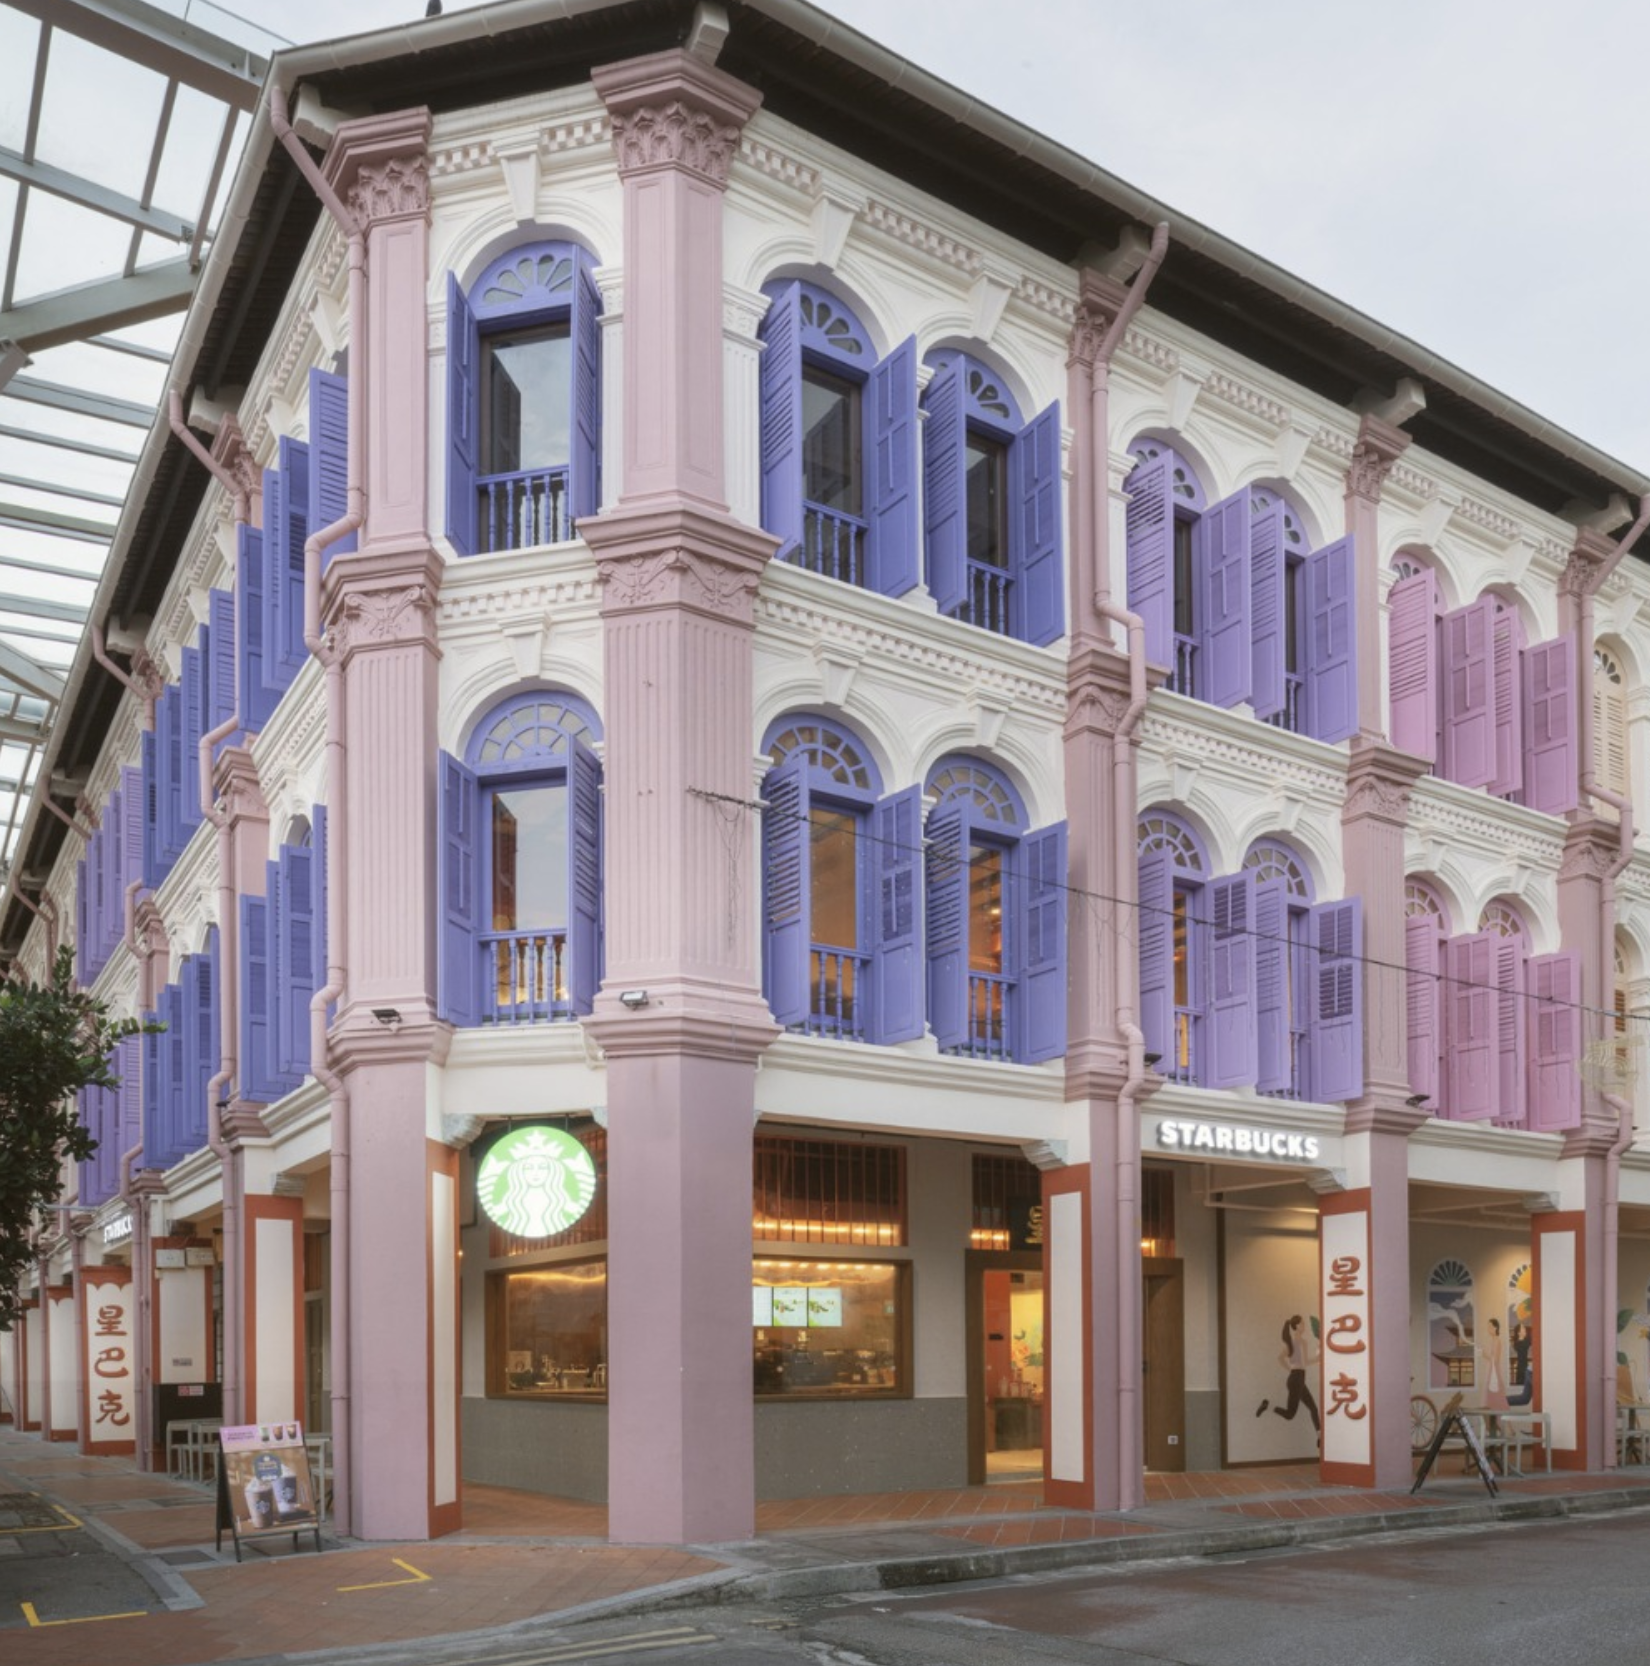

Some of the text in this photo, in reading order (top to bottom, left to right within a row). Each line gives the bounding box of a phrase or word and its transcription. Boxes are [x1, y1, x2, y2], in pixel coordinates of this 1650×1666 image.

[1159, 1120, 1319, 1159] STARBUCKS
[94, 1304, 131, 1426] 星巴克
[1326, 1255, 1367, 1420] 星巴克
